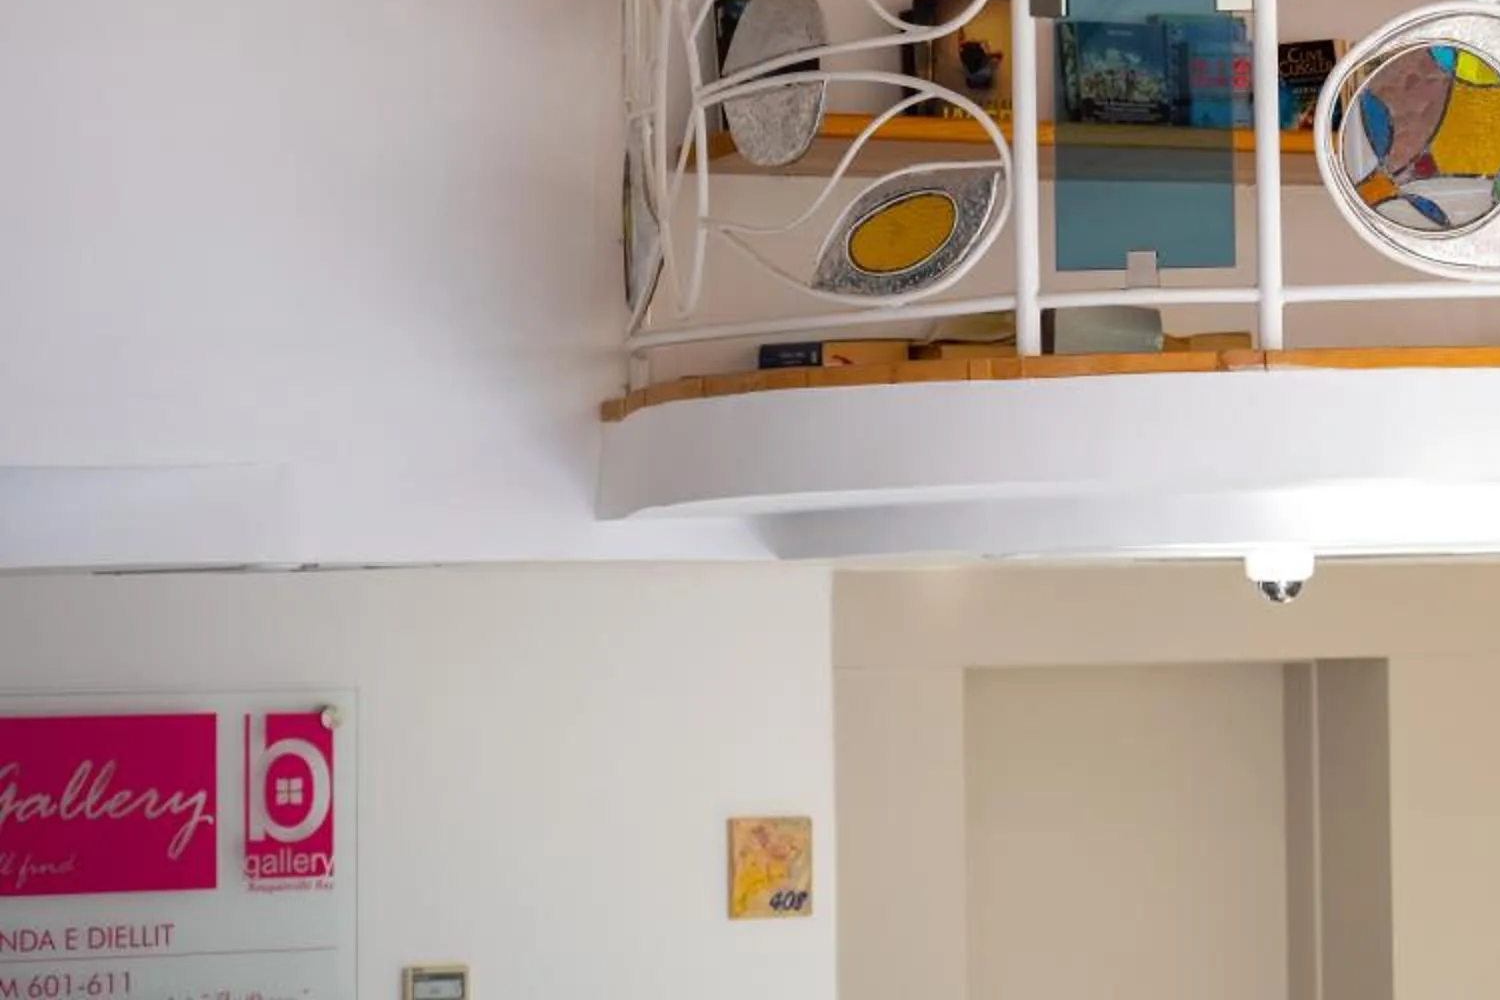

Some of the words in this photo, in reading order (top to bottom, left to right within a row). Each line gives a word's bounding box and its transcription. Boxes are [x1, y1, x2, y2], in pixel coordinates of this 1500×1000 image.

[243, 847, 335, 886] gallery
[65, 927, 79, 951] E
[88, 923, 175, 949] DIELLIT
[28, 971, 130, 999] 601-611
